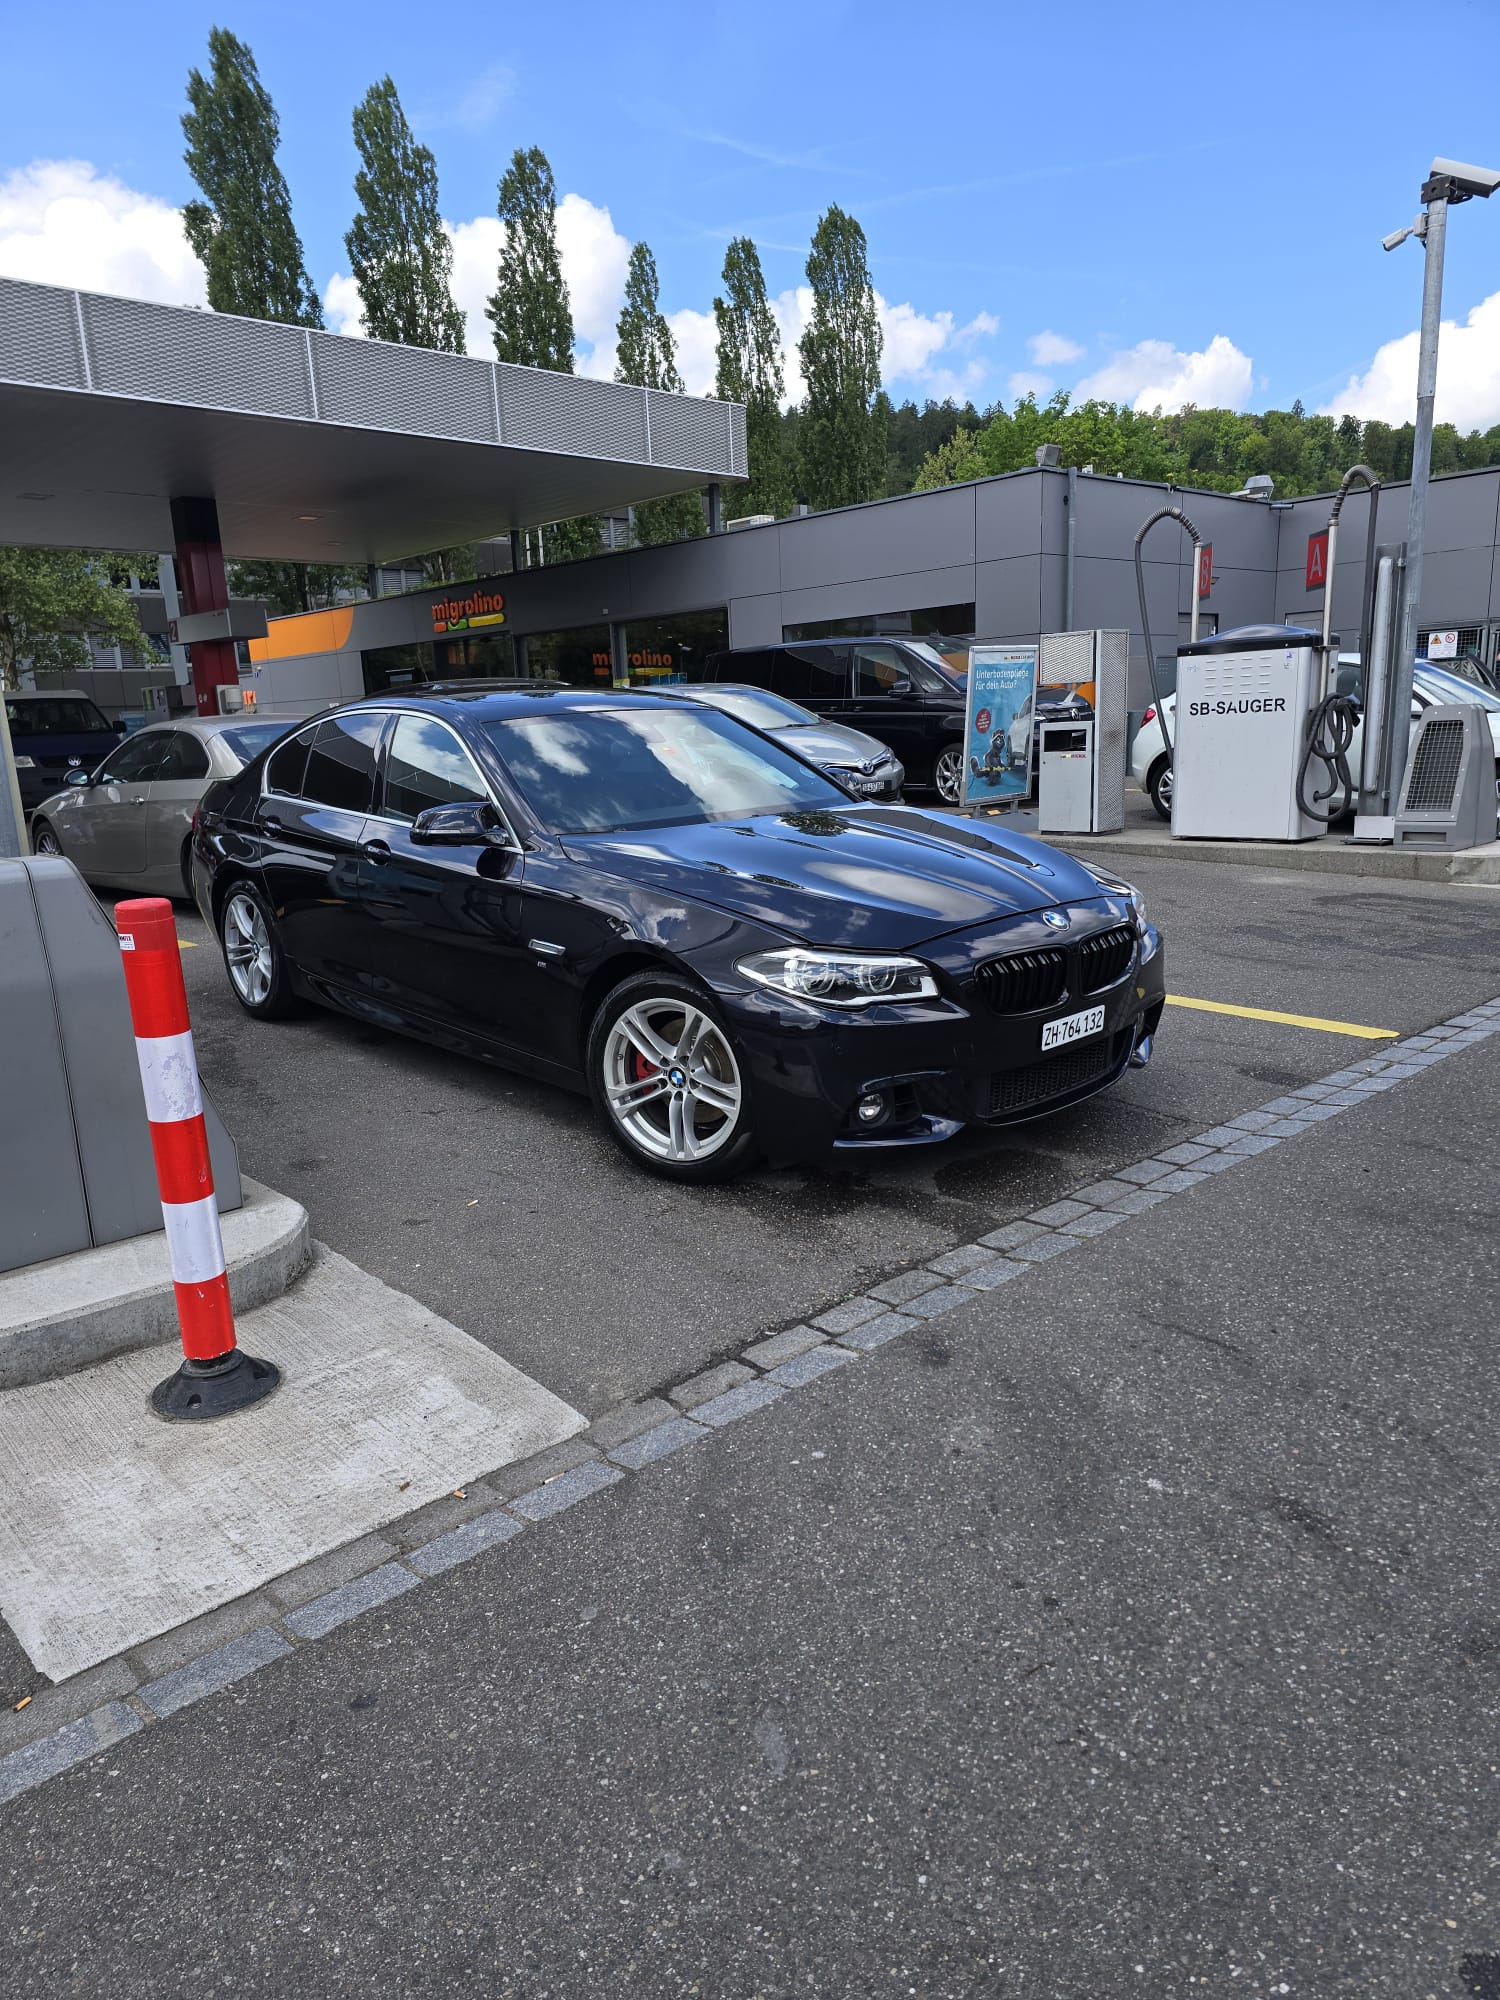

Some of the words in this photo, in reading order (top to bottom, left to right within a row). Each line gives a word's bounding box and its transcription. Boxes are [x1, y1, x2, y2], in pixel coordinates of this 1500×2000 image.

[1309, 543, 1323, 580] A
[1200, 555, 1209, 590] B
[431, 591, 503, 624] migrolino
[170, 622, 177, 642] 2
[592, 649, 673, 666] mirolino
[986, 680, 999, 690] dein
[1000, 679, 1017, 689] Auto?
[1189, 697, 1286, 716] SB-SAUGER
[1083, 1010, 1103, 1033] 132
